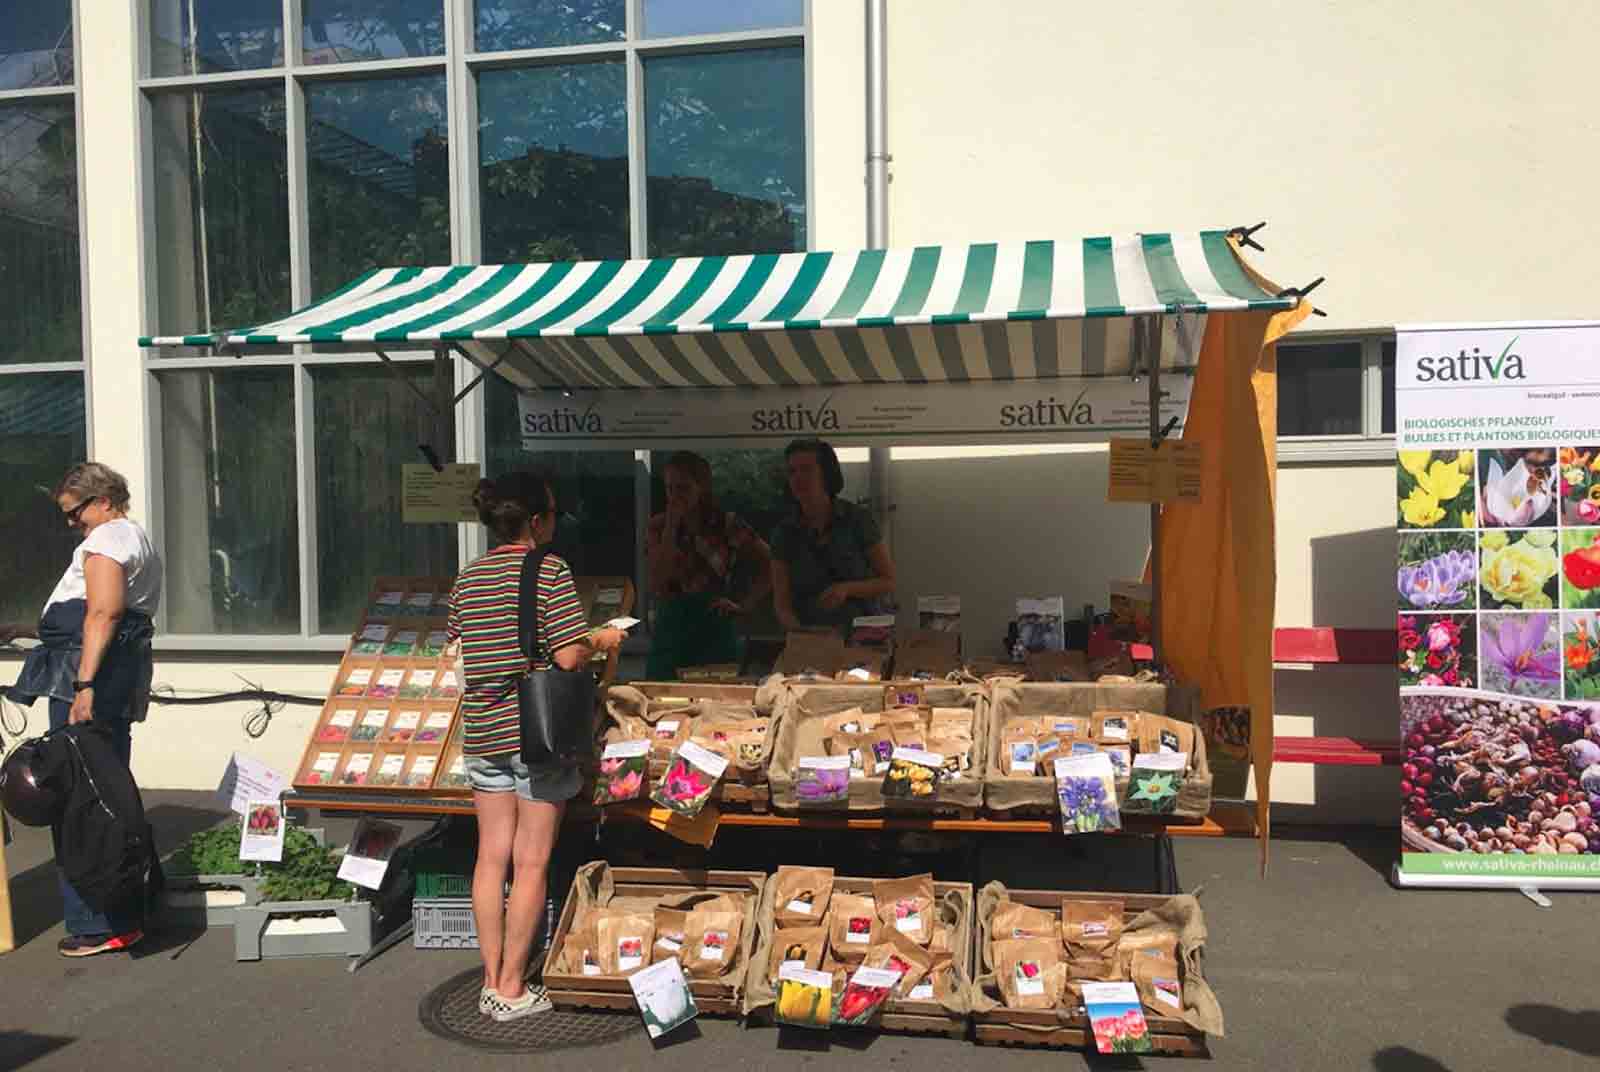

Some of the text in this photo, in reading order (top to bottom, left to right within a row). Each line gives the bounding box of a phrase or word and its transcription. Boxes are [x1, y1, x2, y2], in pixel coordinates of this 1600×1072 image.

[1415, 335, 1526, 382] sativa
[524, 402, 603, 433] sativa
[752, 394, 840, 431] sativa
[1000, 387, 1094, 426] sativa
[1404, 416, 1555, 429] BIOLOGISCHES PFLANZGUT
[1404, 431, 1446, 443] BULBES
[1448, 432, 1462, 442] ET
[1464, 430, 1526, 442] PLANTONS
[1441, 856, 1600, 873] www.sativa-rheinau.c
